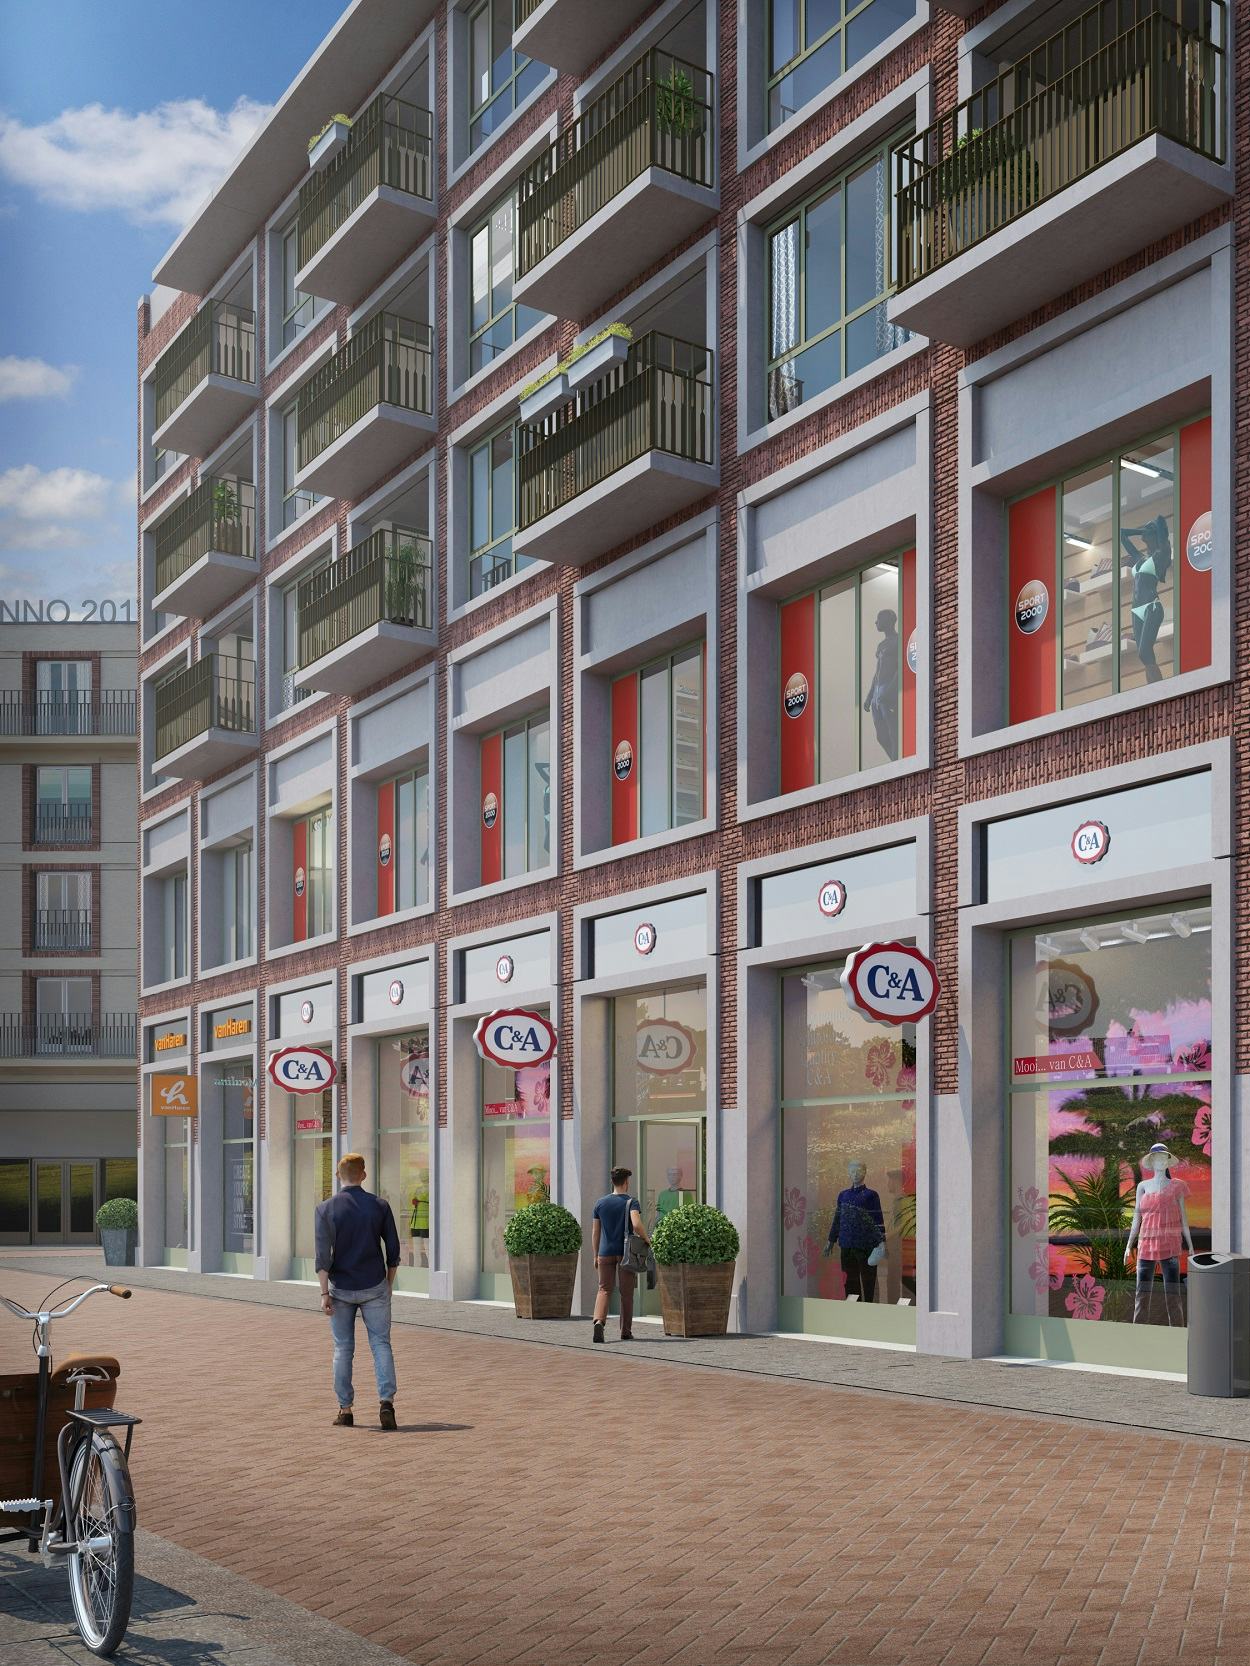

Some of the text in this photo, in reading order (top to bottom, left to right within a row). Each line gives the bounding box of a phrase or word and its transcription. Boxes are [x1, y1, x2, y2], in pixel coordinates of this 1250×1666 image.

[0, 599, 131, 622] NNO 201
[1018, 593, 1046, 612] SPORT
[1020, 605, 1043, 621] 2000
[786, 684, 806, 698] SPORT
[788, 694, 804, 707] 2000
[1078, 832, 1100, 852] C&A
[822, 889, 838, 906] C&A
[867, 964, 925, 1002] C&A
[494, 1025, 543, 1052] C&A
[282, 1059, 325, 1081] C&A
[1049, 1060, 1066, 1070] van
[1068, 1054, 1092, 1069] C&A
